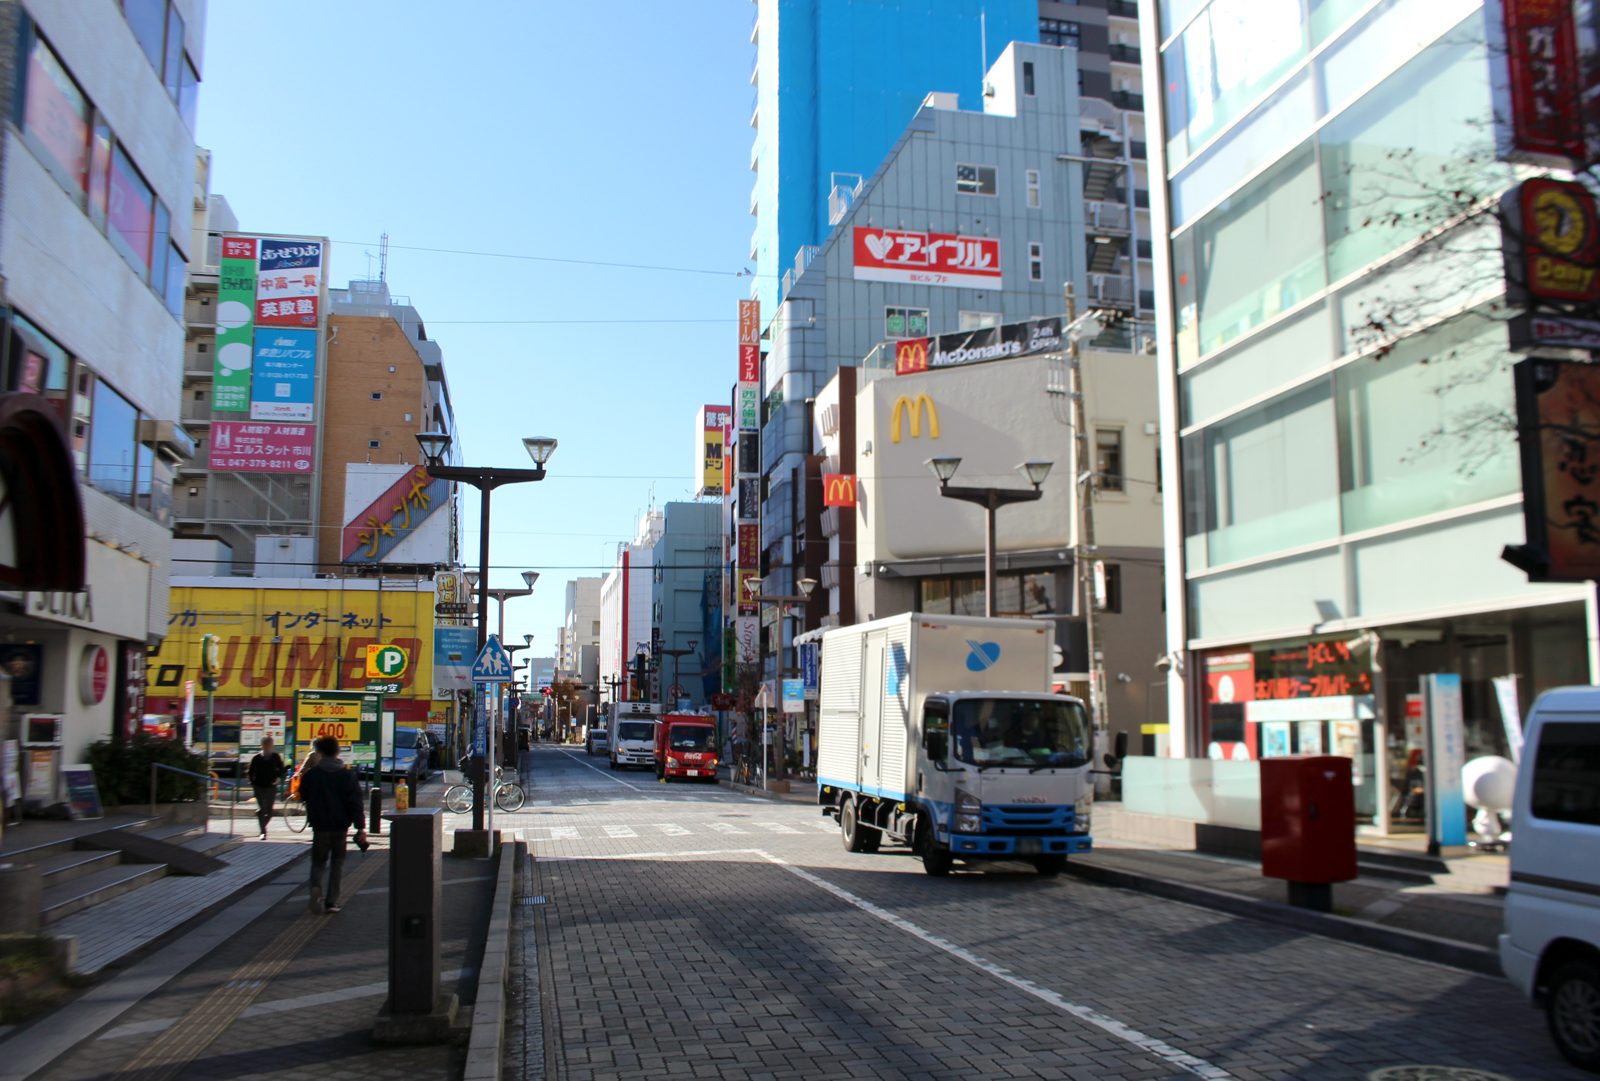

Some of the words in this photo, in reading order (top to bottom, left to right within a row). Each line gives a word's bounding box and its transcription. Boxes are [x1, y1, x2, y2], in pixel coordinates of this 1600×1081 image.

[896, 235, 991, 268] アイフル
[261, 299, 314, 317] 英数塾
[745, 346, 755, 381] アイフル
[932, 339, 1022, 366] McDonald's
[265, 610, 393, 630] インターネット
[384, 651, 402, 673] P
